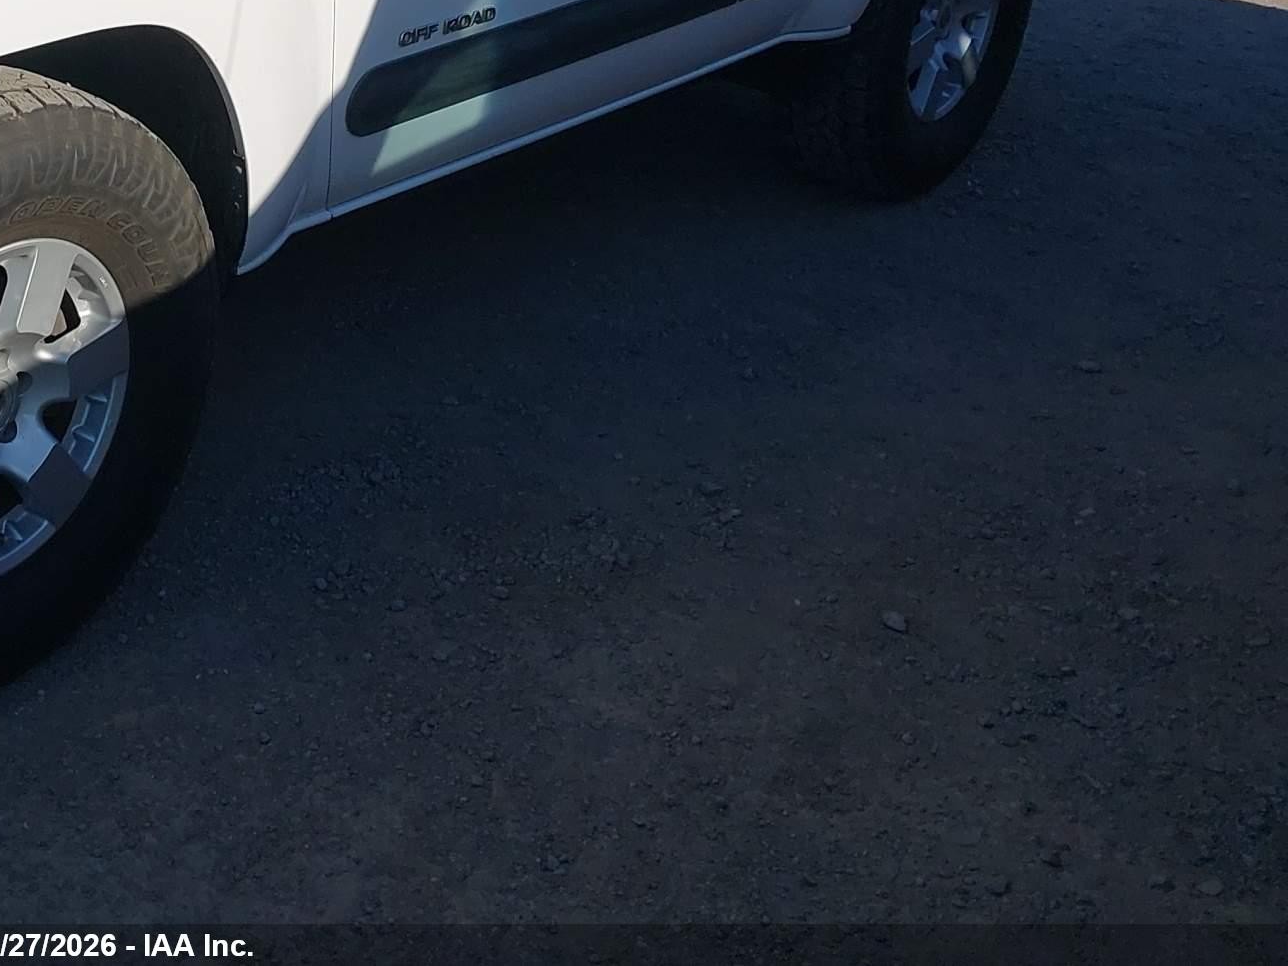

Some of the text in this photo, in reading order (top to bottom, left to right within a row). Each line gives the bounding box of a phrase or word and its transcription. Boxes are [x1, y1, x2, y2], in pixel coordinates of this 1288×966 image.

[398, 7, 496, 47] OFF ROAD
[10, 198, 106, 221] OPEN
